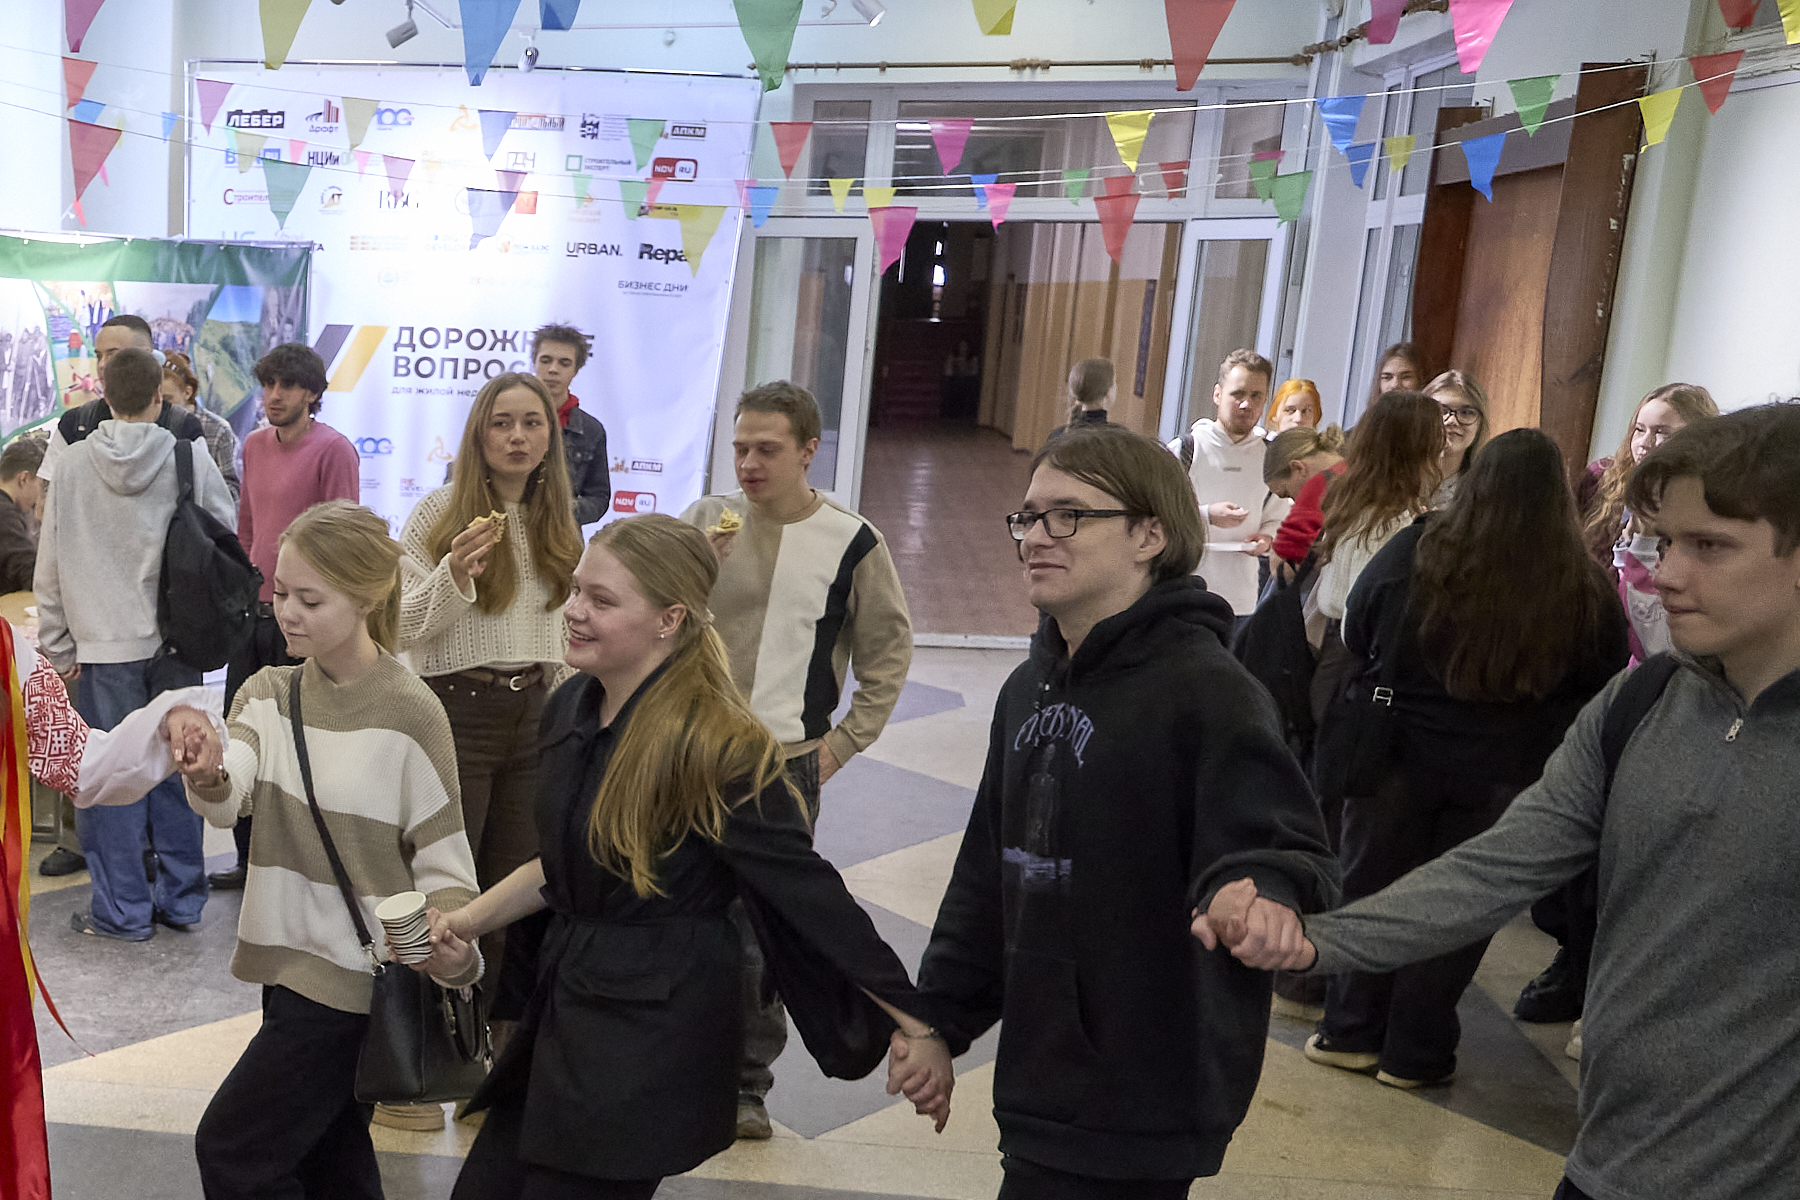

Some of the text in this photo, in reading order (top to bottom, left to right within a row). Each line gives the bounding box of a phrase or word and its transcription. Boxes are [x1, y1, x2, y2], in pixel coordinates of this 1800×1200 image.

[227, 112, 284, 128] ЛЕБЕР
[618, 280, 688, 292] БИЗНЕС ДНИ
[393, 355, 535, 381] ВОПРОС
[392, 386, 412, 395] для
[415, 386, 453, 396] жилой
